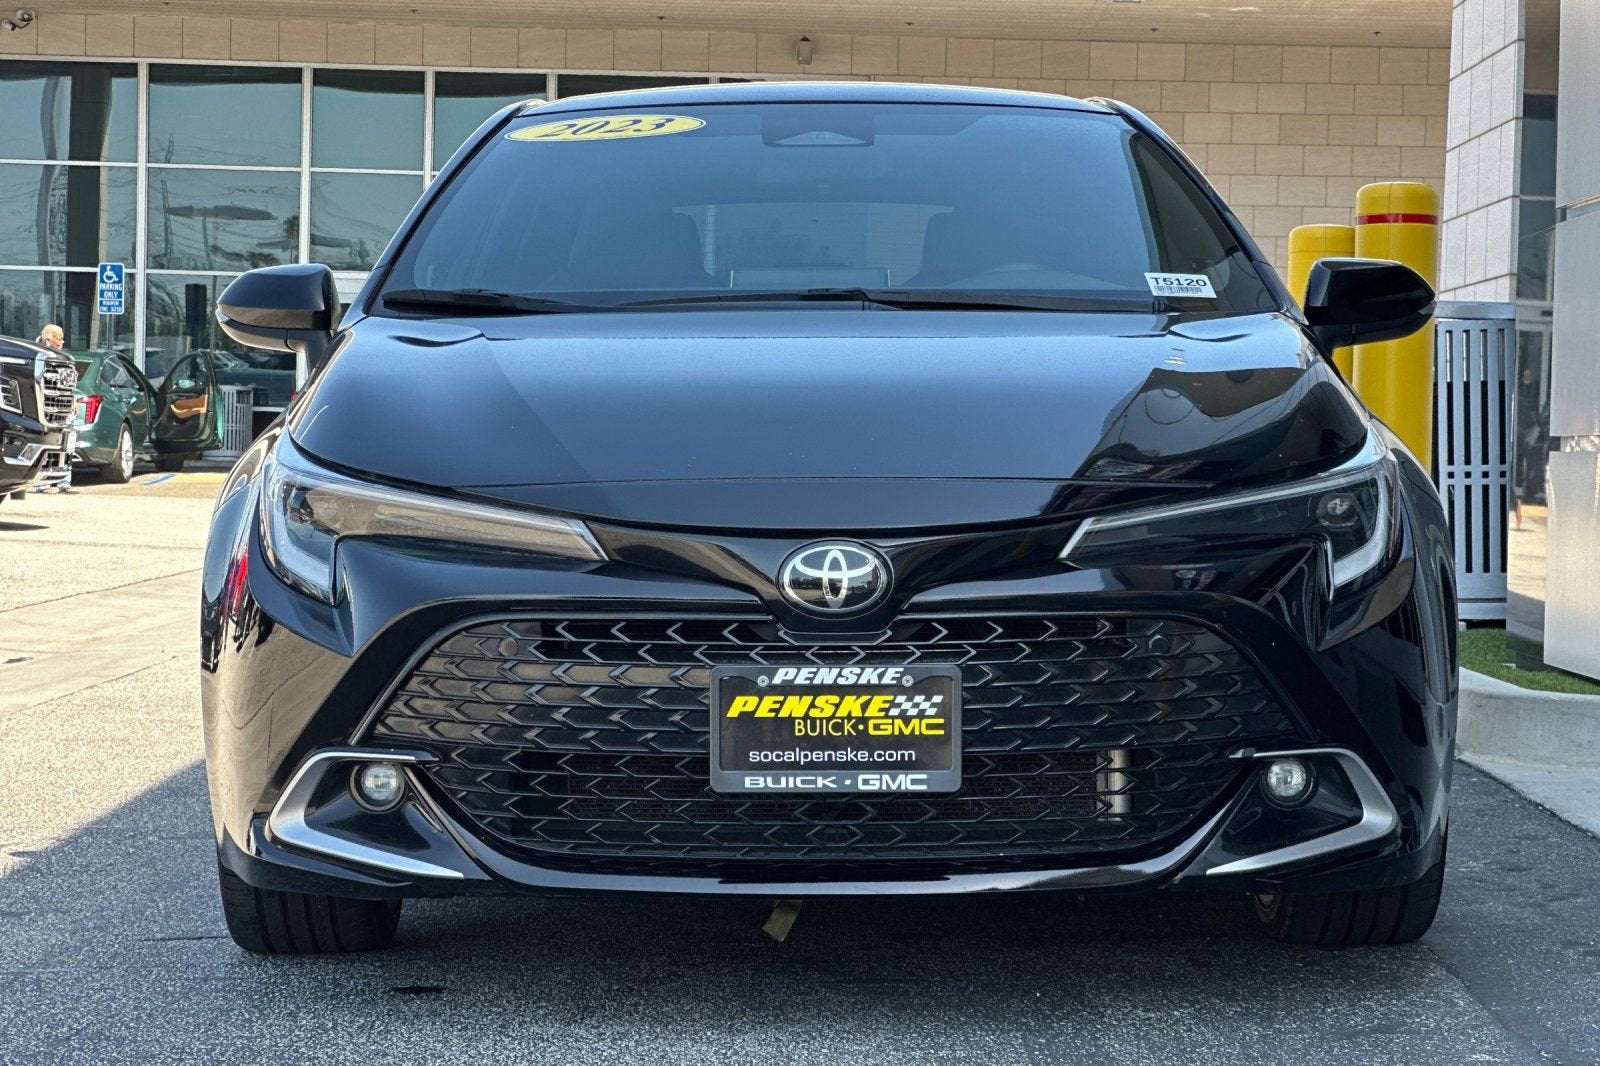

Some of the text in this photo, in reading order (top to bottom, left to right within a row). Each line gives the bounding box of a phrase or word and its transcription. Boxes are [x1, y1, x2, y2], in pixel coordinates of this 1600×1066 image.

[534, 117, 676, 139] 2023
[99, 283, 123, 291] PARKING
[1150, 277, 1207, 287] T5120
[103, 291, 119, 299] ONLY
[771, 667, 905, 685] PENSKE
[725, 695, 895, 718] PENSKE
[748, 747, 916, 765] socalpenske.com
[744, 773, 928, 790] BUICK GMC
